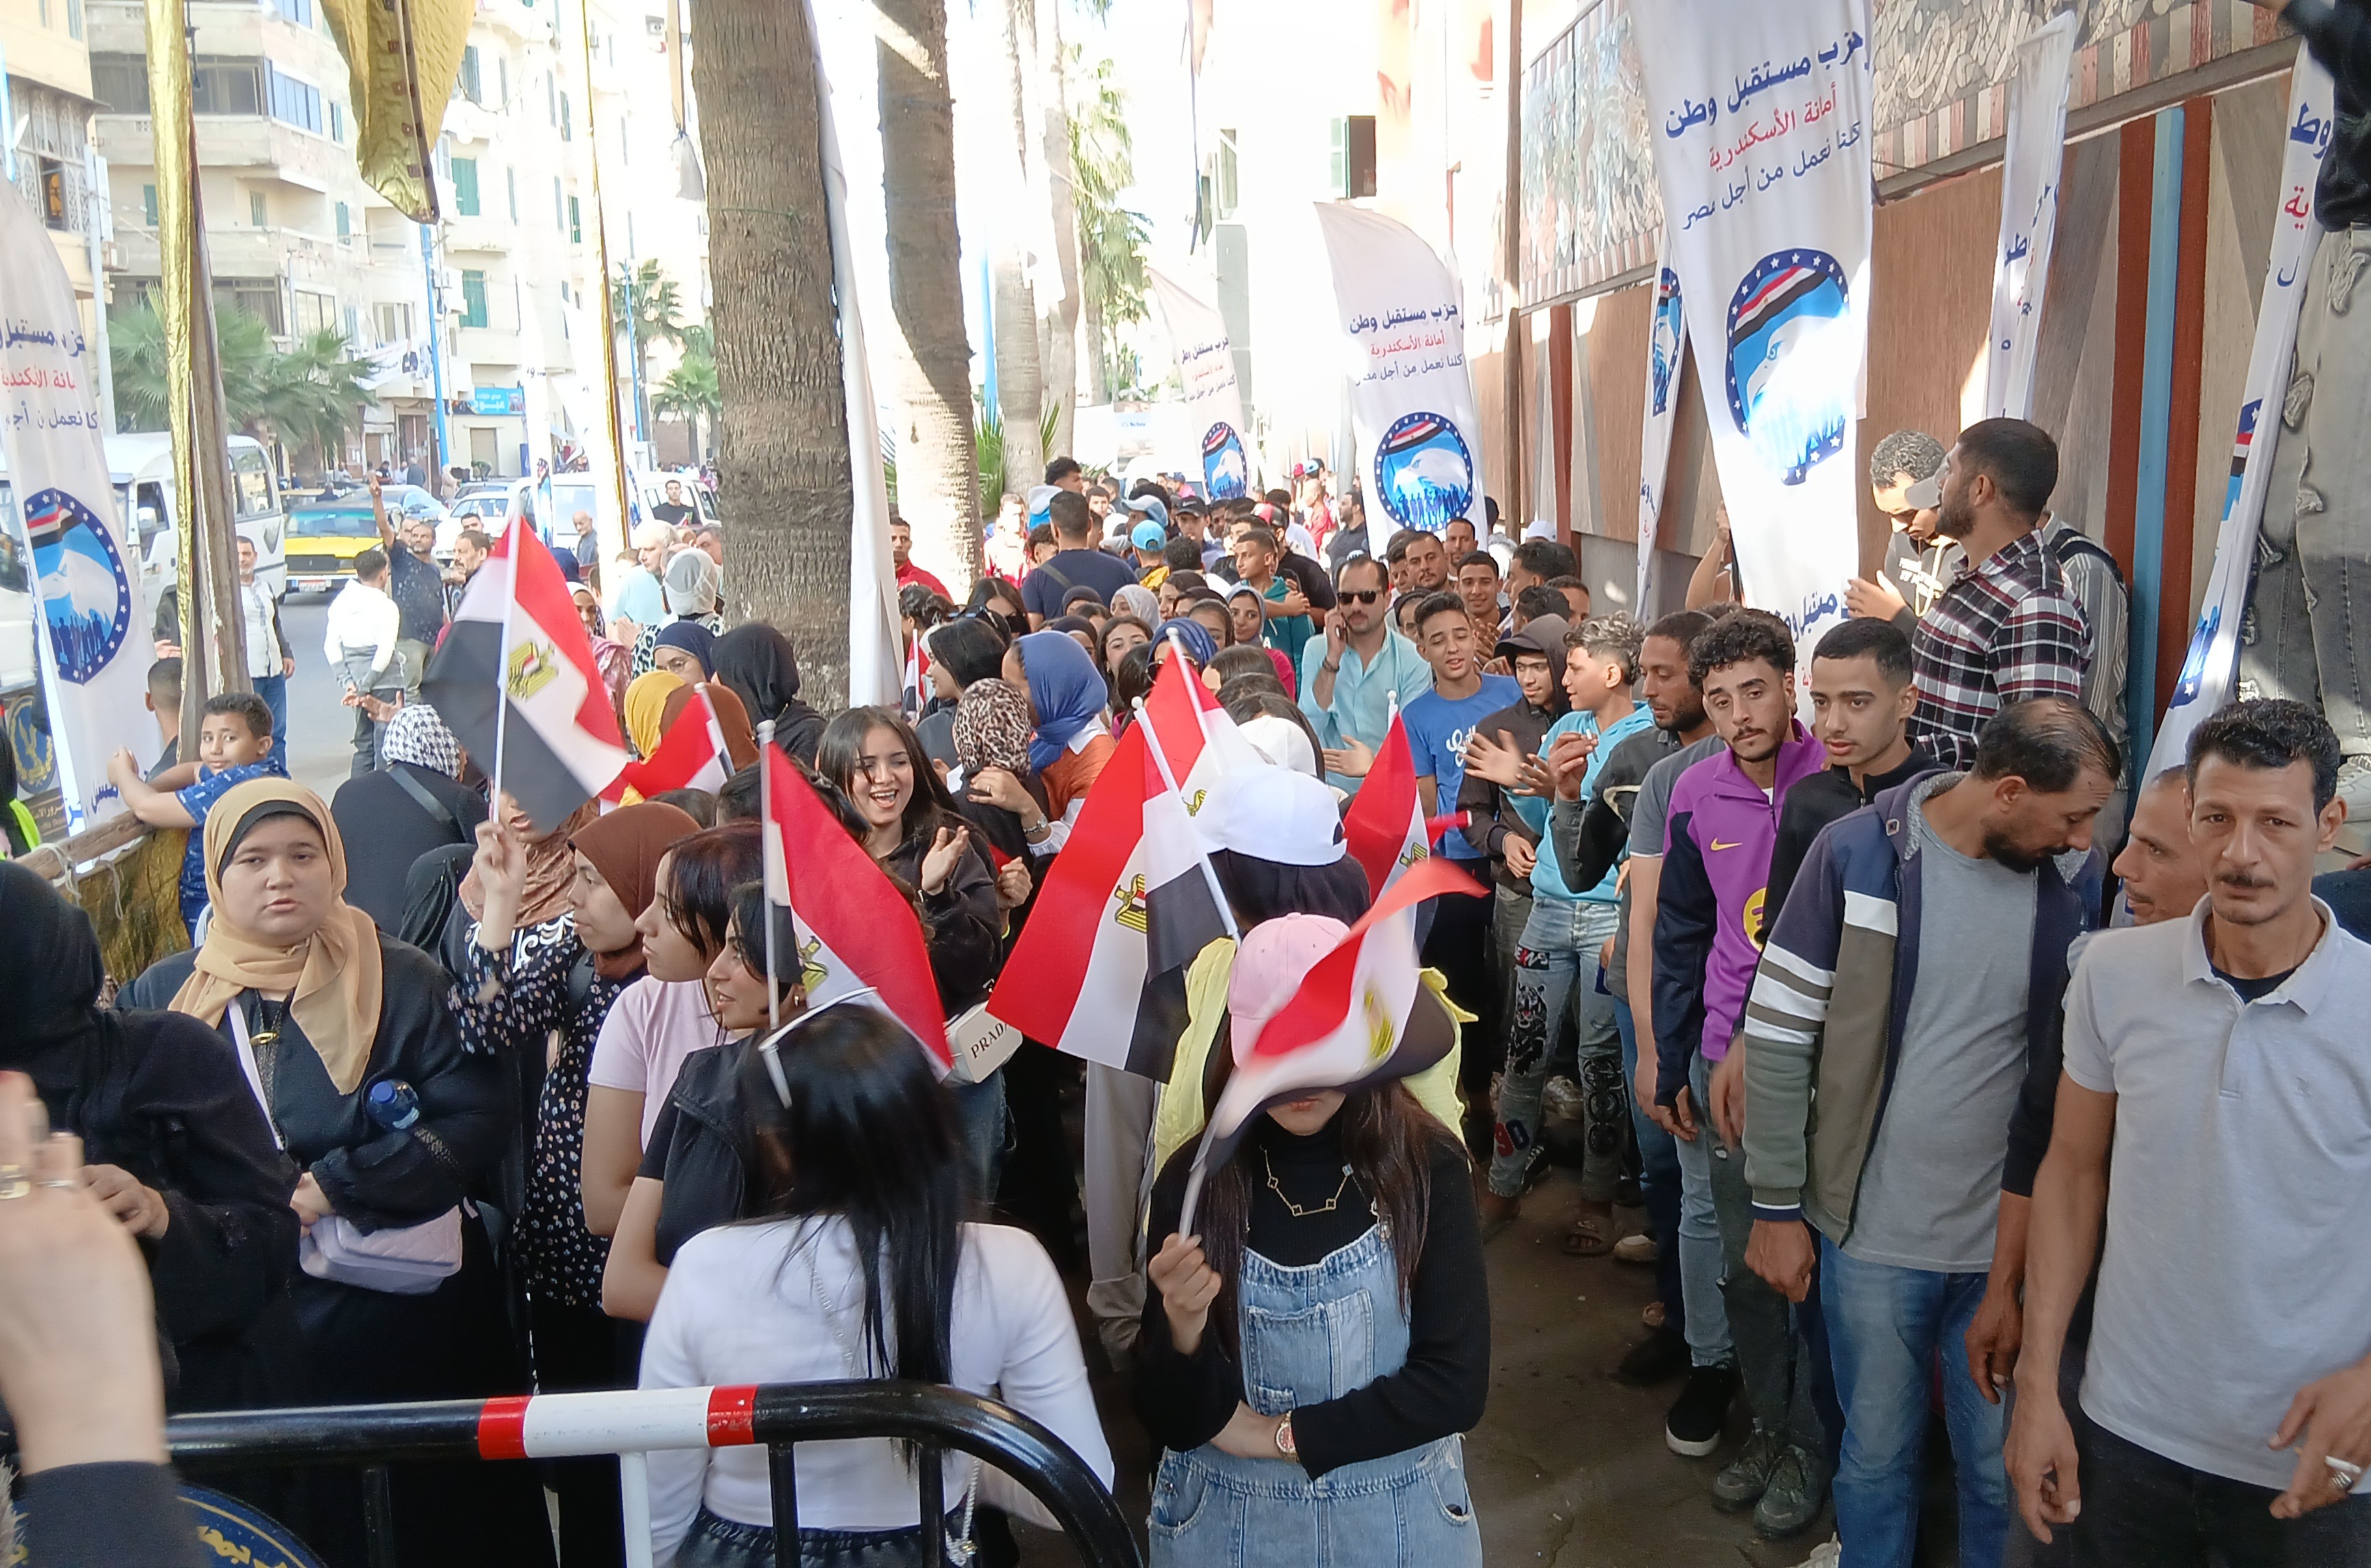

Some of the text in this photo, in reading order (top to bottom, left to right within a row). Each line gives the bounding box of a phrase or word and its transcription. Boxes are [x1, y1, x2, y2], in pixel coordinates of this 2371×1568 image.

[1728, 56, 1811, 114] مستقبل
[1666, 97, 1718, 139] وطن
[1709, 81, 1837, 173] أمانة الأسكندرية
[1793, 138, 1832, 178] نعمل
[1756, 166, 1784, 192] من
[1349, 303, 1458, 334] حزب مستقبل وطن
[1371, 329, 1445, 359] أمانة الأسكندرية
[1380, 361, 1399, 381] أجل
[1403, 365, 1417, 378] من
[1421, 358, 1444, 374] نعمل
[1446, 353, 1463, 367] كلنا
[48, 408, 83, 429] نعمل
